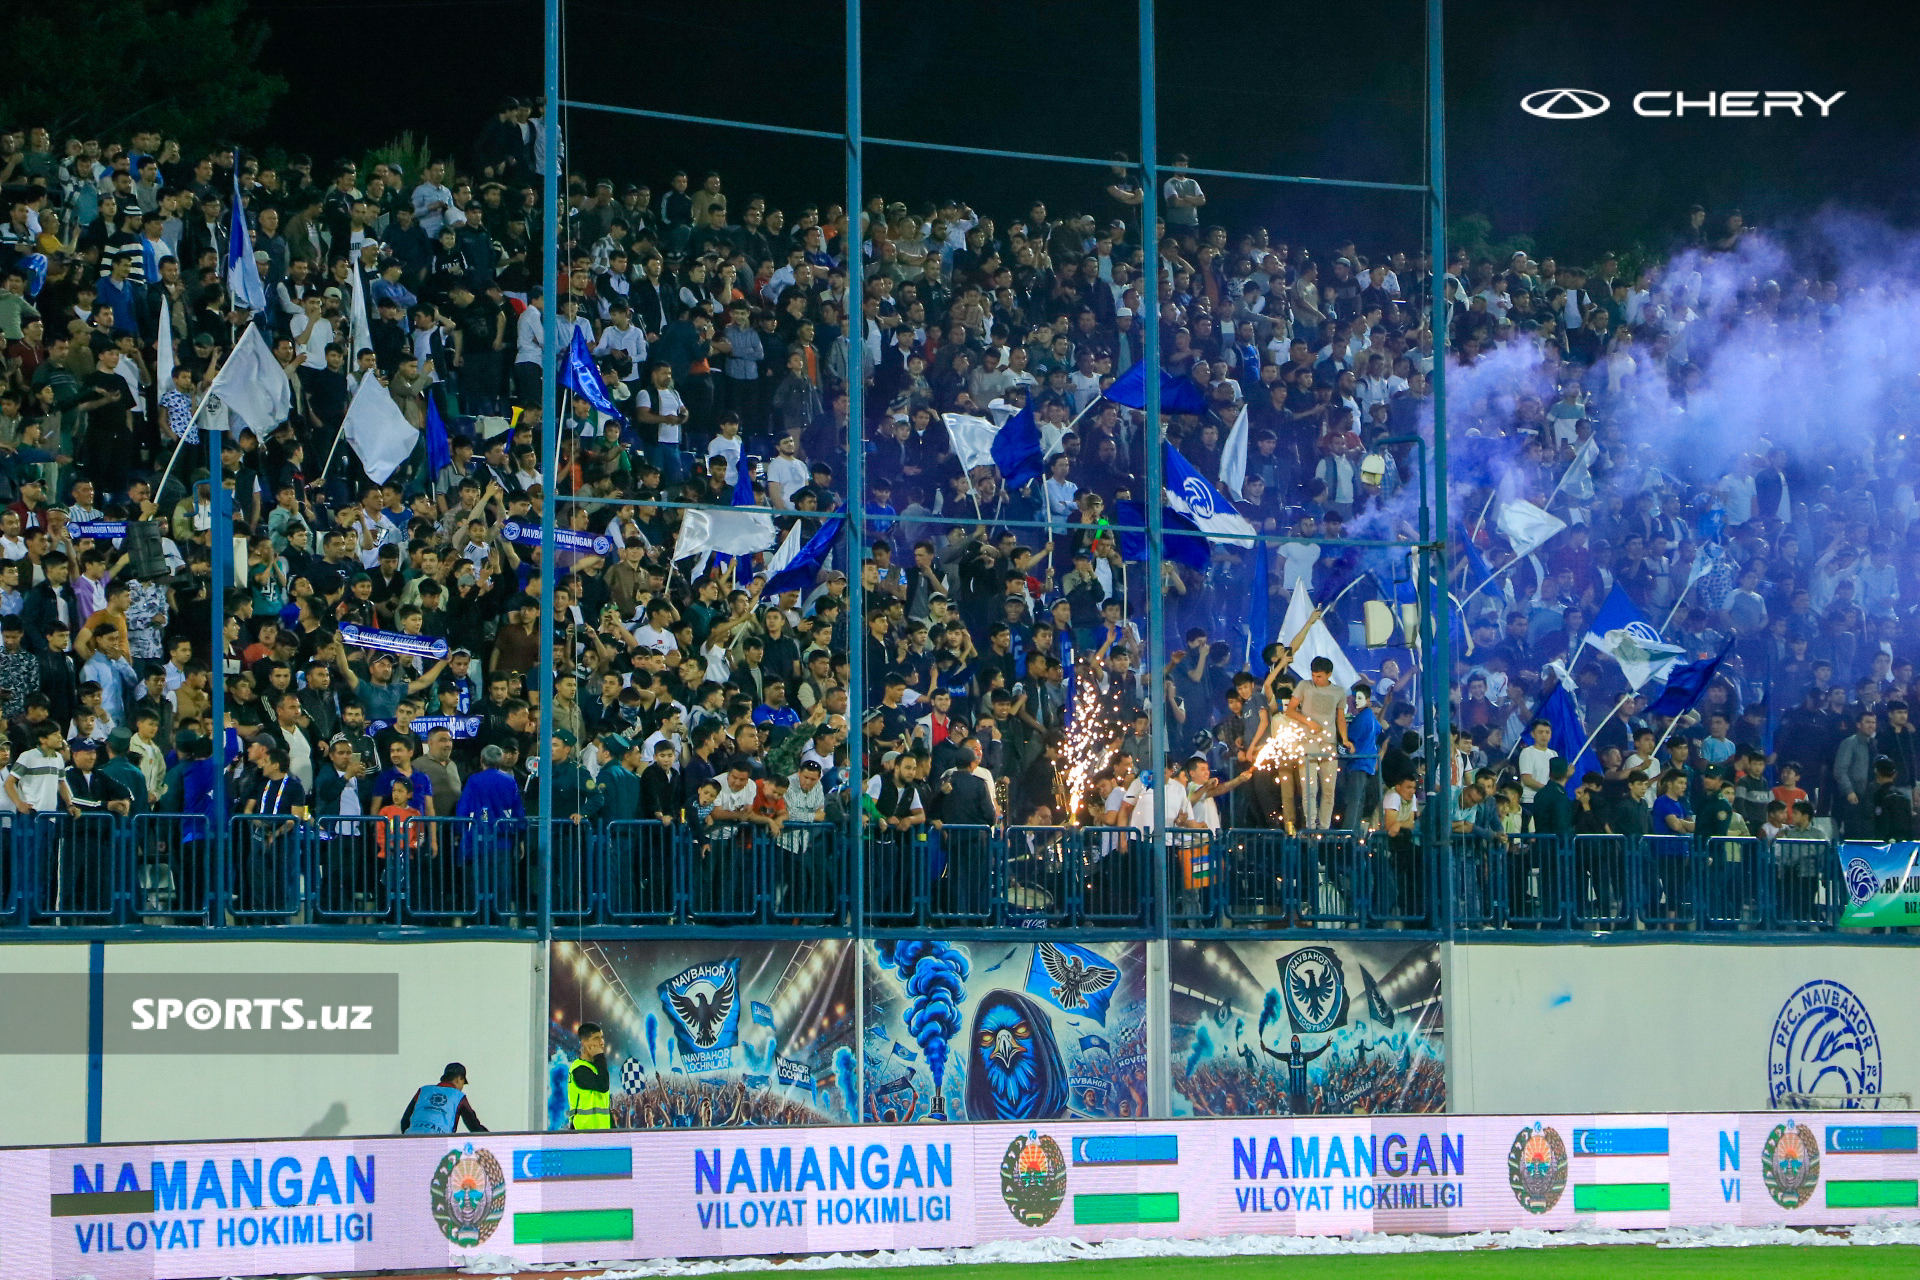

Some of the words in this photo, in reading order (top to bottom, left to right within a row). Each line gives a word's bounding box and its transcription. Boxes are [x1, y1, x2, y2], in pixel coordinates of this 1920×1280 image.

[556, 534, 592, 548] NAMANGAN
[672, 965, 727, 990] NAVBAHOR
[1298, 1014, 1333, 1032] FOOTBALL
[1801, 988, 1873, 1052] NAVBAHOR
[683, 1049, 731, 1063] NAVBAHOR
[686, 1059, 729, 1073] LOCHINLAR
[776, 1056, 809, 1075] NAVBOR
[1773, 1063, 1784, 1075] 19
[1866, 1065, 1877, 1077] 78
[694, 1143, 953, 1195] NAMANGAN
[1232, 1133, 1464, 1180] NAMANGAN
[73, 1155, 375, 1212] NAMANGAN
[1236, 1185, 1333, 1213] VILOYAT
[1342, 1182, 1463, 1211] HOKIMLIGI
[696, 1199, 807, 1230] VILOYAT
[817, 1195, 951, 1226] HOKIMLIGI
[75, 1219, 205, 1254] VILOYAT
[217, 1212, 373, 1247] HOKIMLIGI
